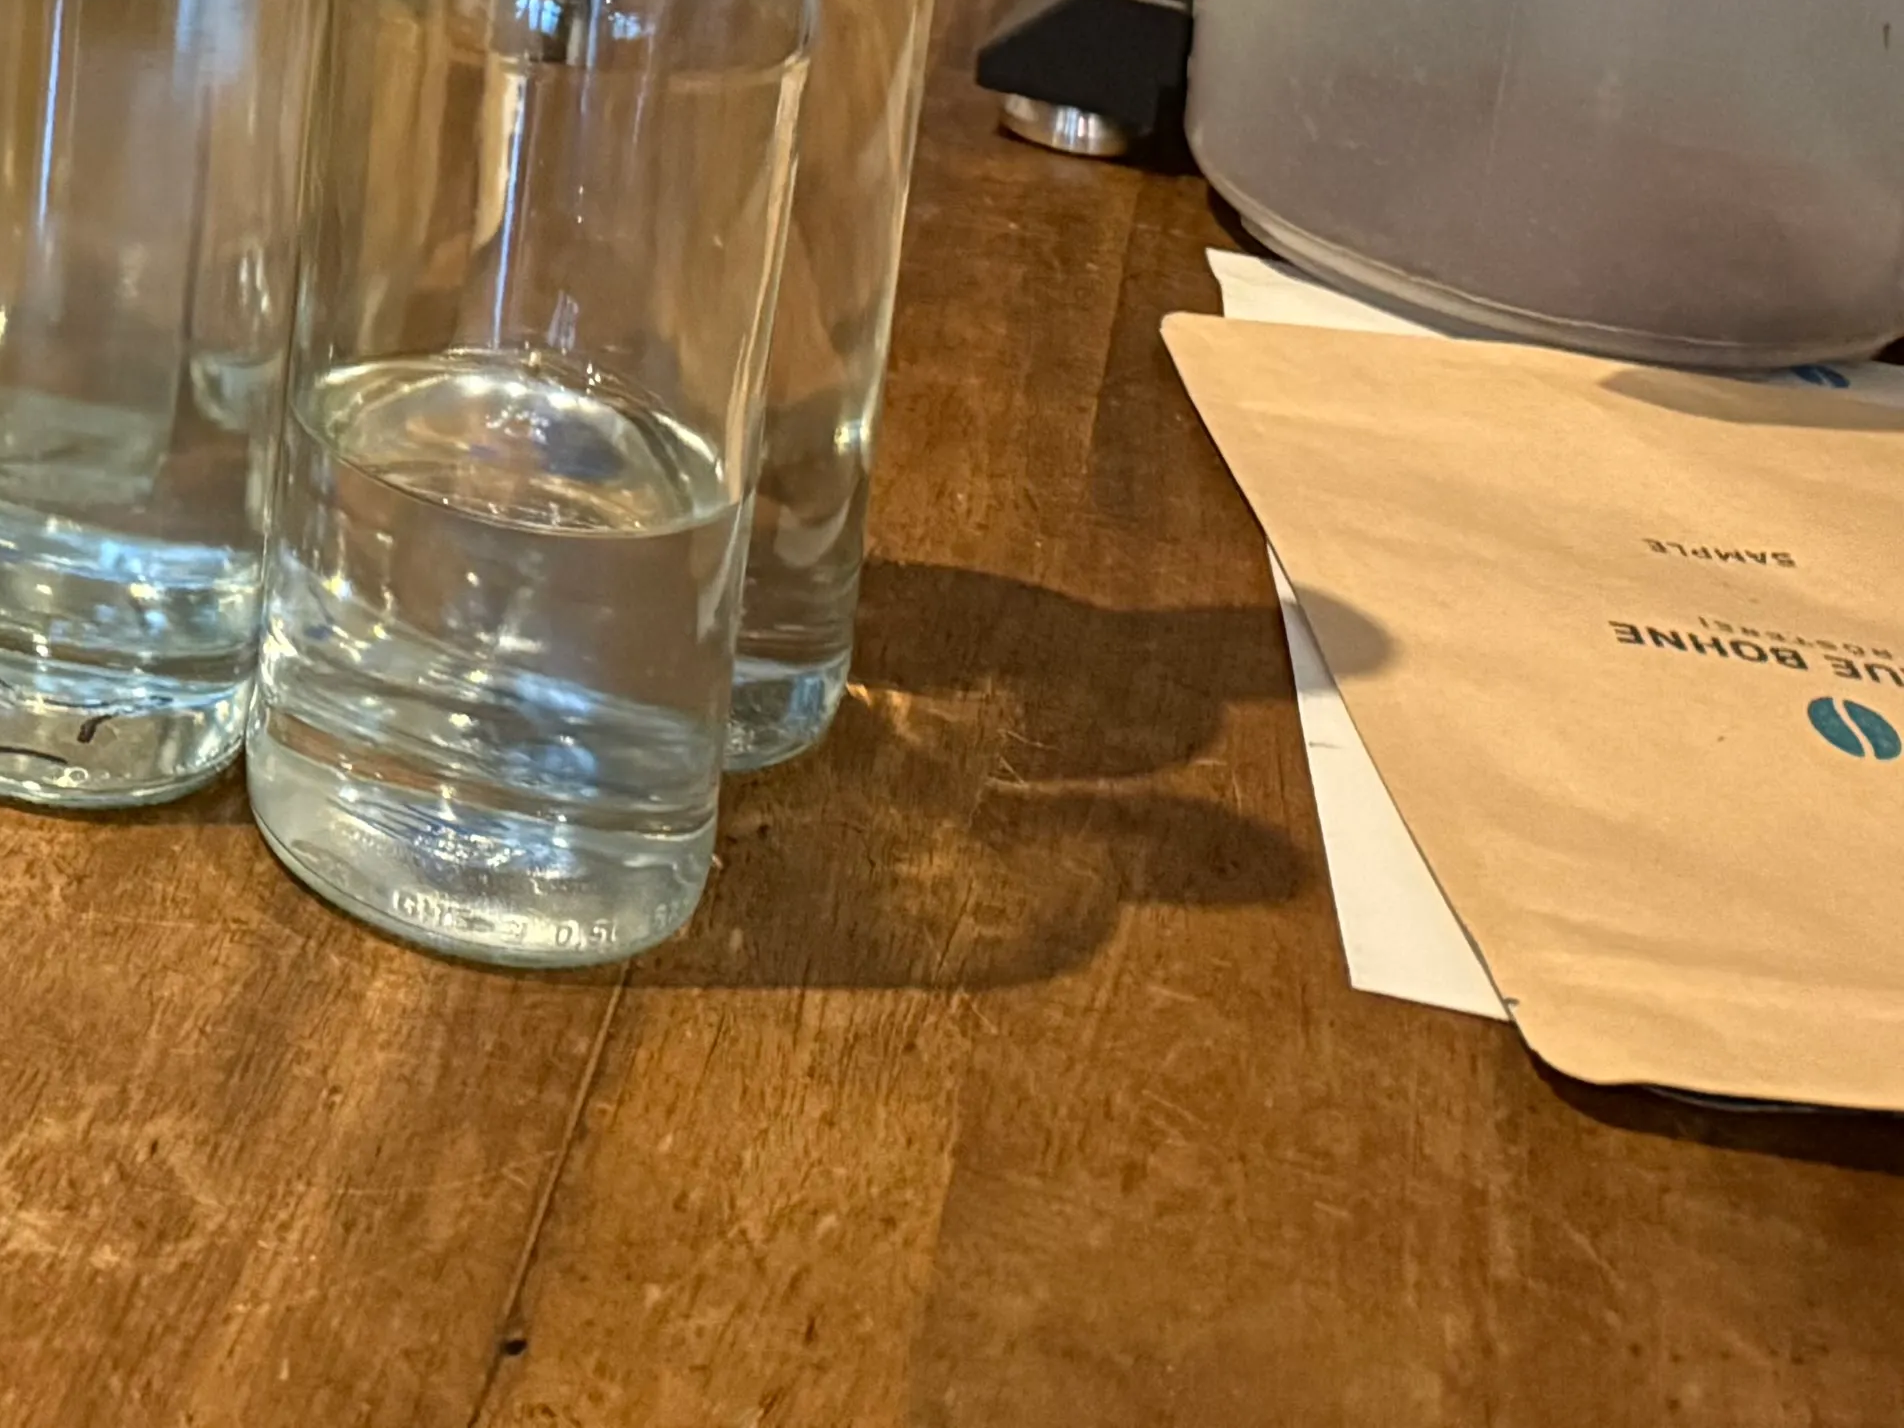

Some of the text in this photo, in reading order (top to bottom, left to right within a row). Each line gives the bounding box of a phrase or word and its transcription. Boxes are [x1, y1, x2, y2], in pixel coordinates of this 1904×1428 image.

[1643, 538, 1796, 568] SAMPLE
[1608, 620, 1904, 688] UE BOHNE
